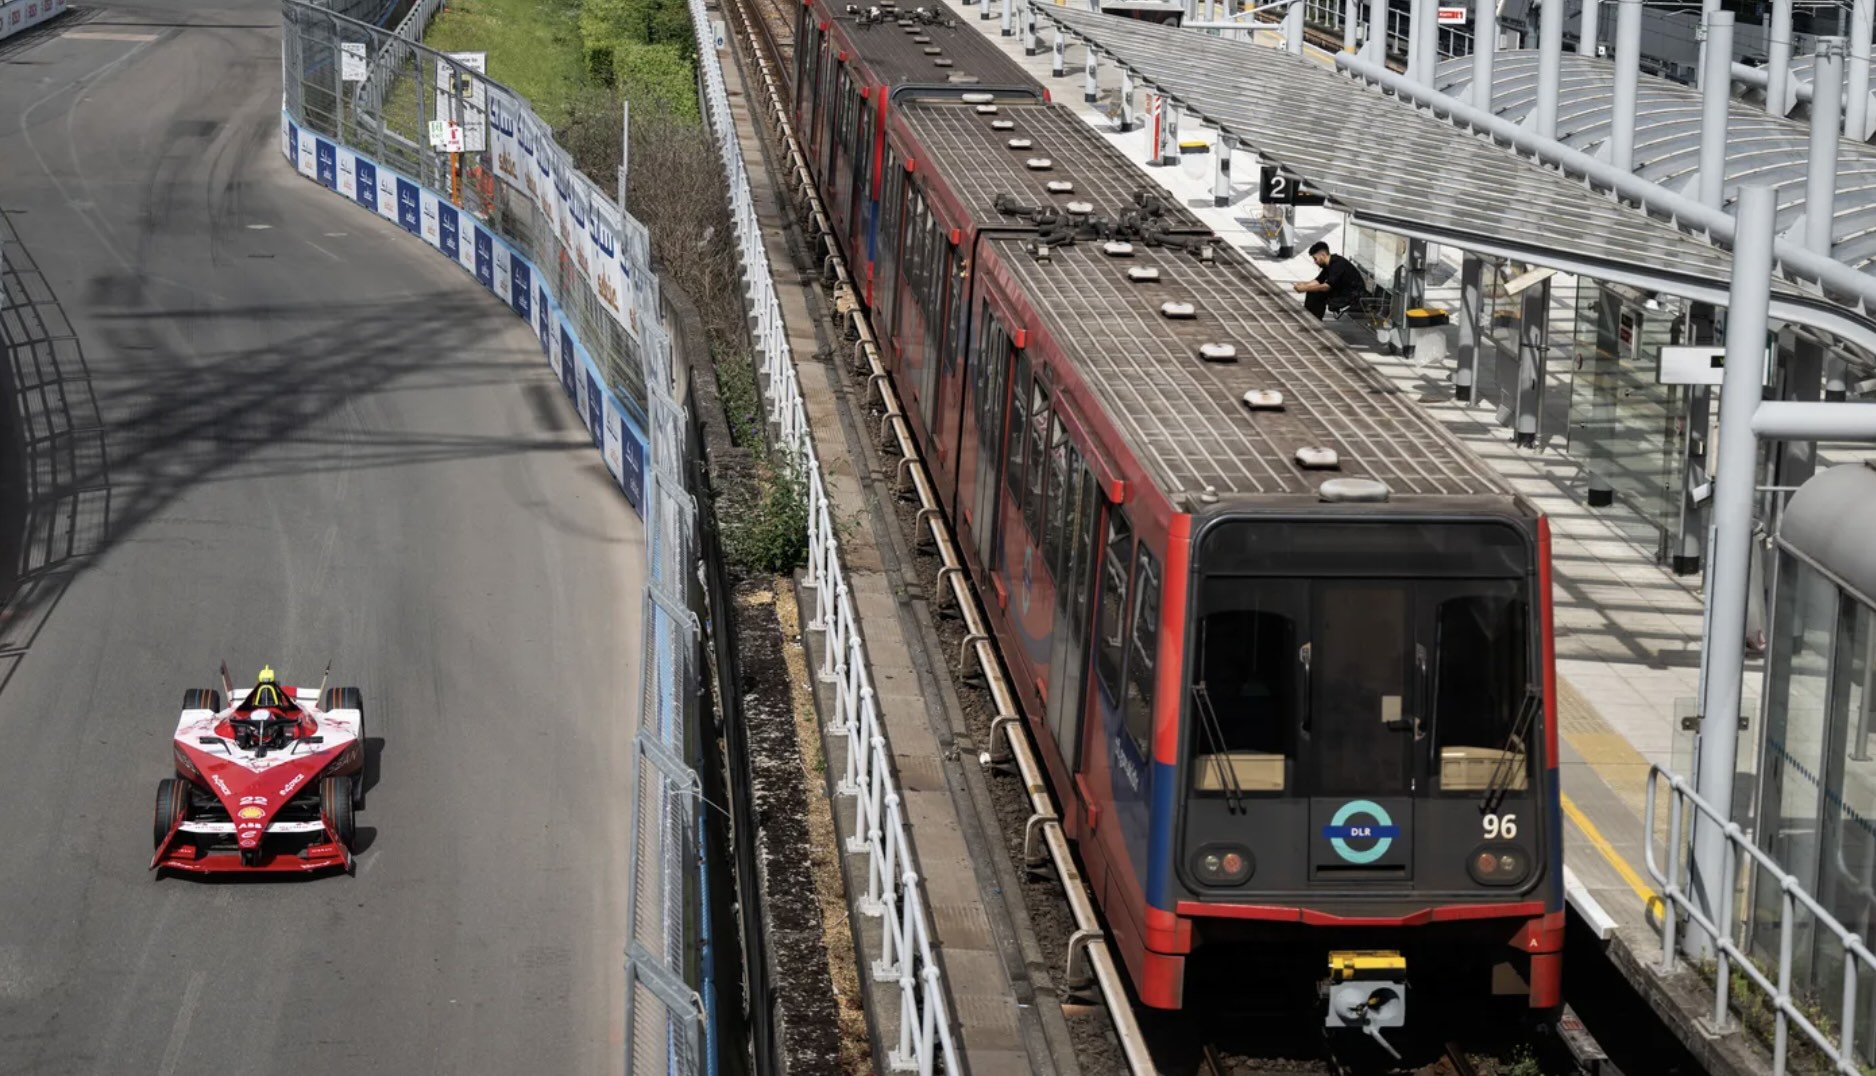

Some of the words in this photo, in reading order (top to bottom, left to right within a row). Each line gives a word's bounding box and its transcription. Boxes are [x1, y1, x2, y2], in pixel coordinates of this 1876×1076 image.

[1270, 176, 1286, 197] 2
[239, 796, 268, 806] 22
[1482, 814, 1517, 839] 96
[1351, 827, 1371, 837] DLR
[1529, 938, 1538, 947] A
